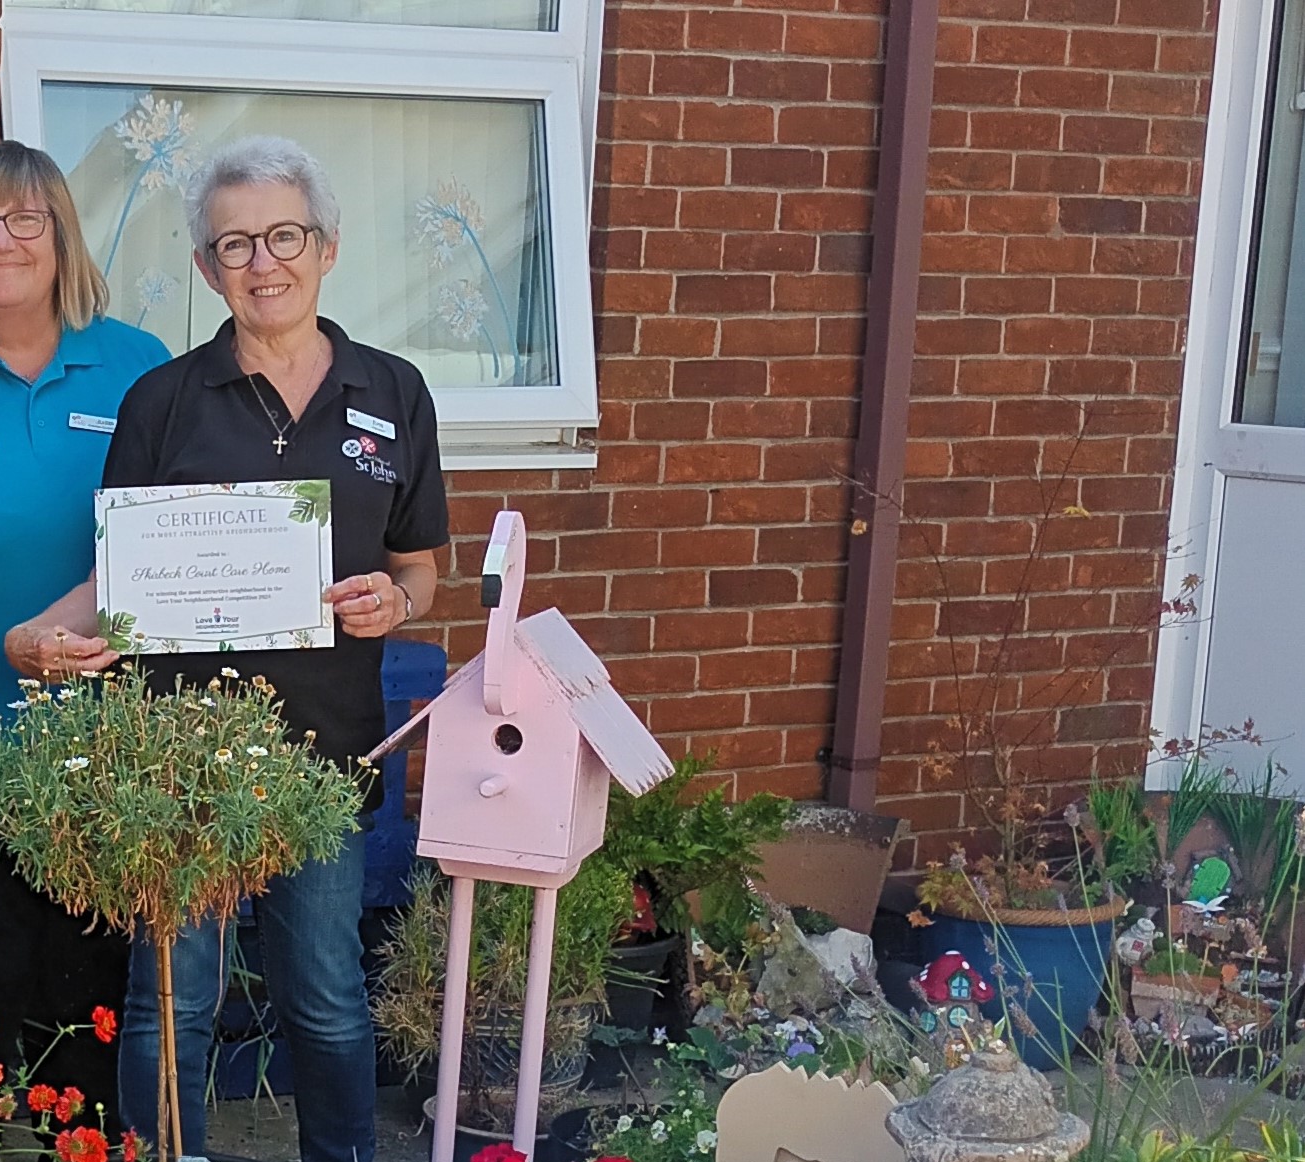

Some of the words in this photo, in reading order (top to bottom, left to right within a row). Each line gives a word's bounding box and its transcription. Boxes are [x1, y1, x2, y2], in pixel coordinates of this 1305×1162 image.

[355, 457, 370, 472] St
[370, 460, 397, 480] John
[156, 508, 268, 528] CERTIFICATE
[185, 565, 218, 580] Court
[221, 563, 249, 578] Care
[251, 561, 291, 576] Home
[194, 616, 213, 624] Love
[222, 615, 240, 623] Your
